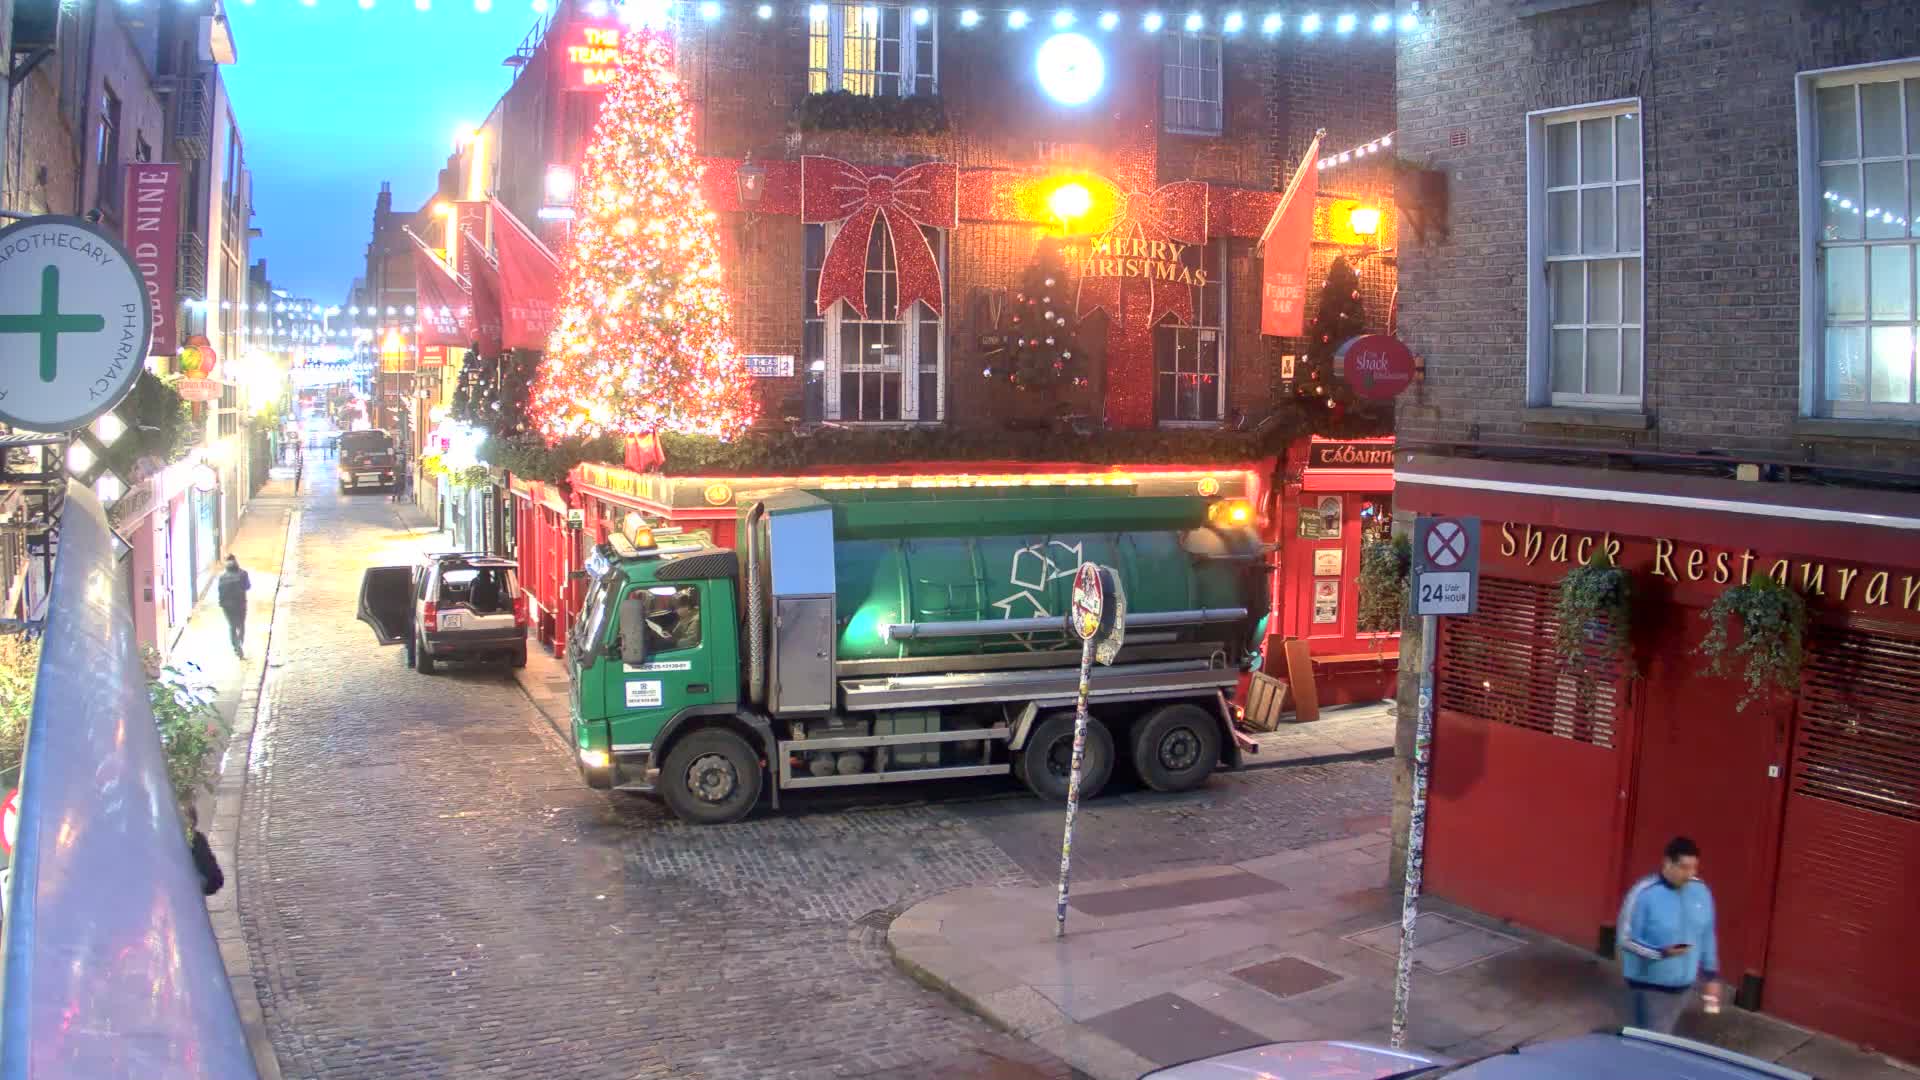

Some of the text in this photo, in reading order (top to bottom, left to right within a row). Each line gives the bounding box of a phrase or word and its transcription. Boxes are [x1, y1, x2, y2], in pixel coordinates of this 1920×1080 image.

[136, 171, 168, 232] NINE
[1090, 236, 1186, 262] MERRY
[1078, 258, 1207, 287] HRISTMAS
[89, 303, 137, 400] PHARMACY
[1356, 352, 1389, 369] Shack
[751, 366, 778, 374] SOUTH
[1422, 584, 1443, 602] 24
